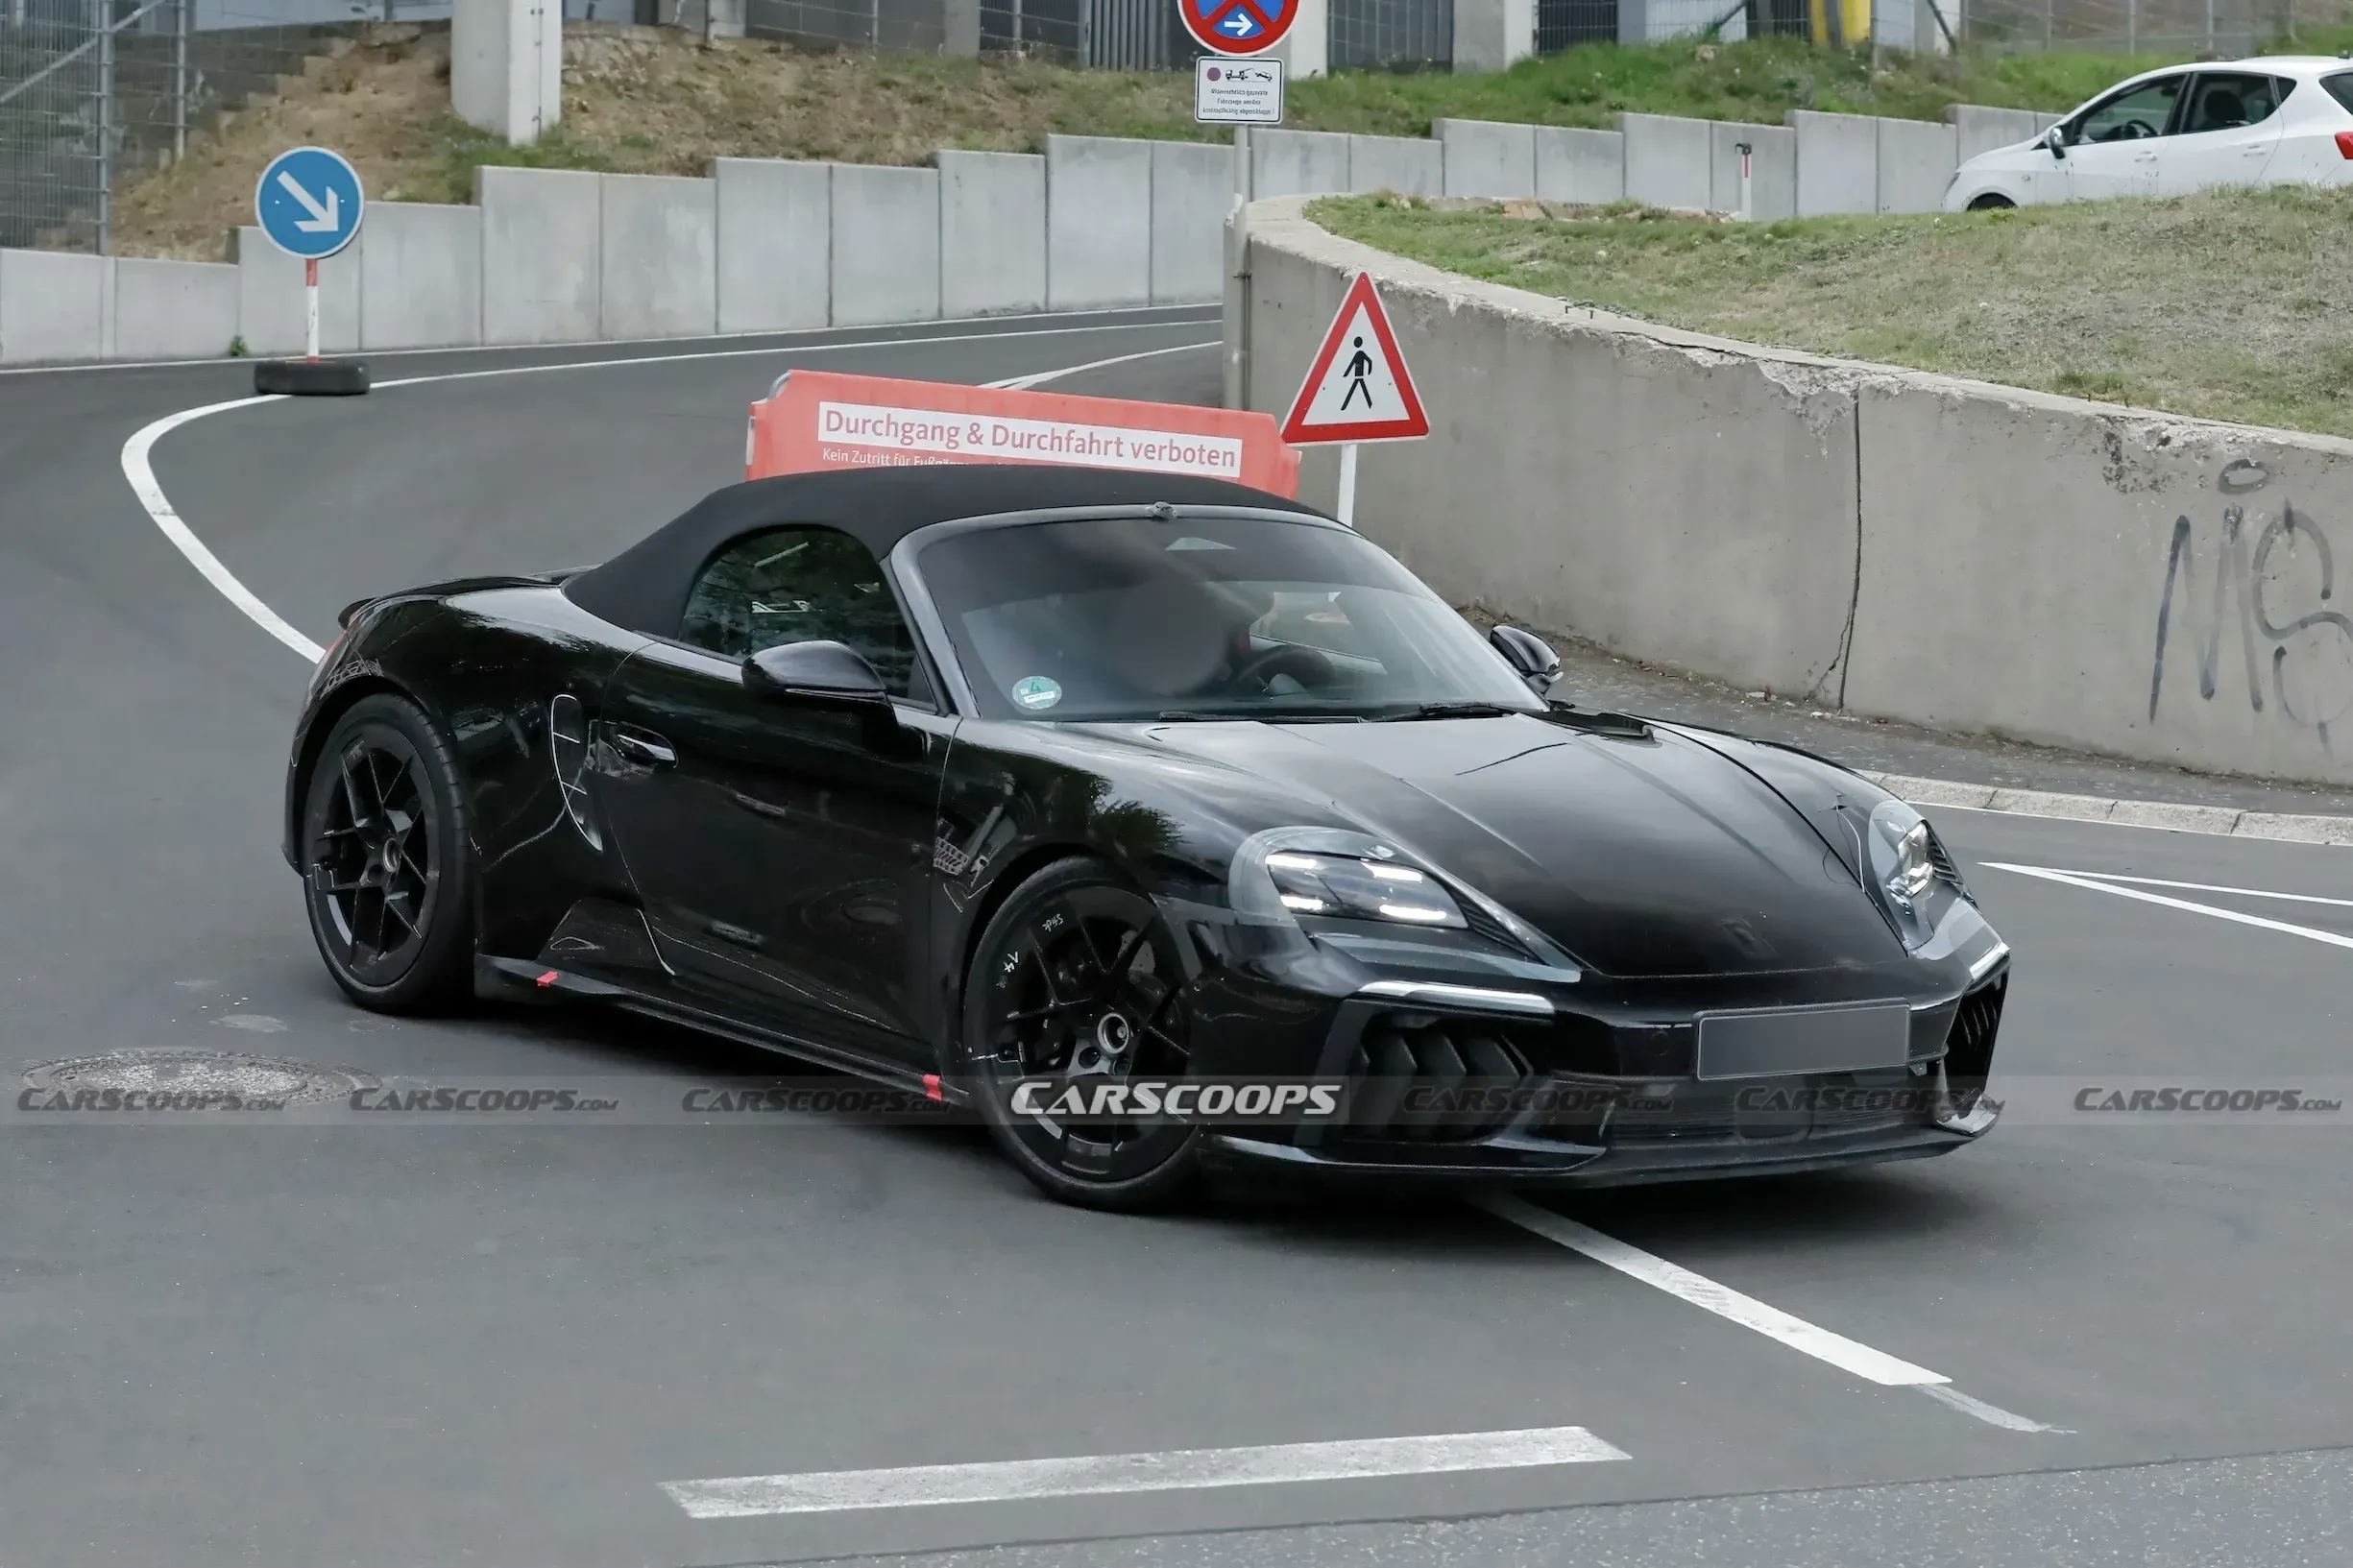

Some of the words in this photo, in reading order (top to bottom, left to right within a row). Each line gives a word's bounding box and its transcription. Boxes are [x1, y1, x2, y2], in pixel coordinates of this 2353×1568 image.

[823, 447, 849, 462] Kein
[851, 449, 891, 467] Zutritt
[894, 452, 911, 467] für
[826, 410, 960, 450] Durchgang
[966, 422, 983, 446] &
[991, 424, 1124, 458] Durchfahrt
[1130, 438, 1235, 468] verboten
